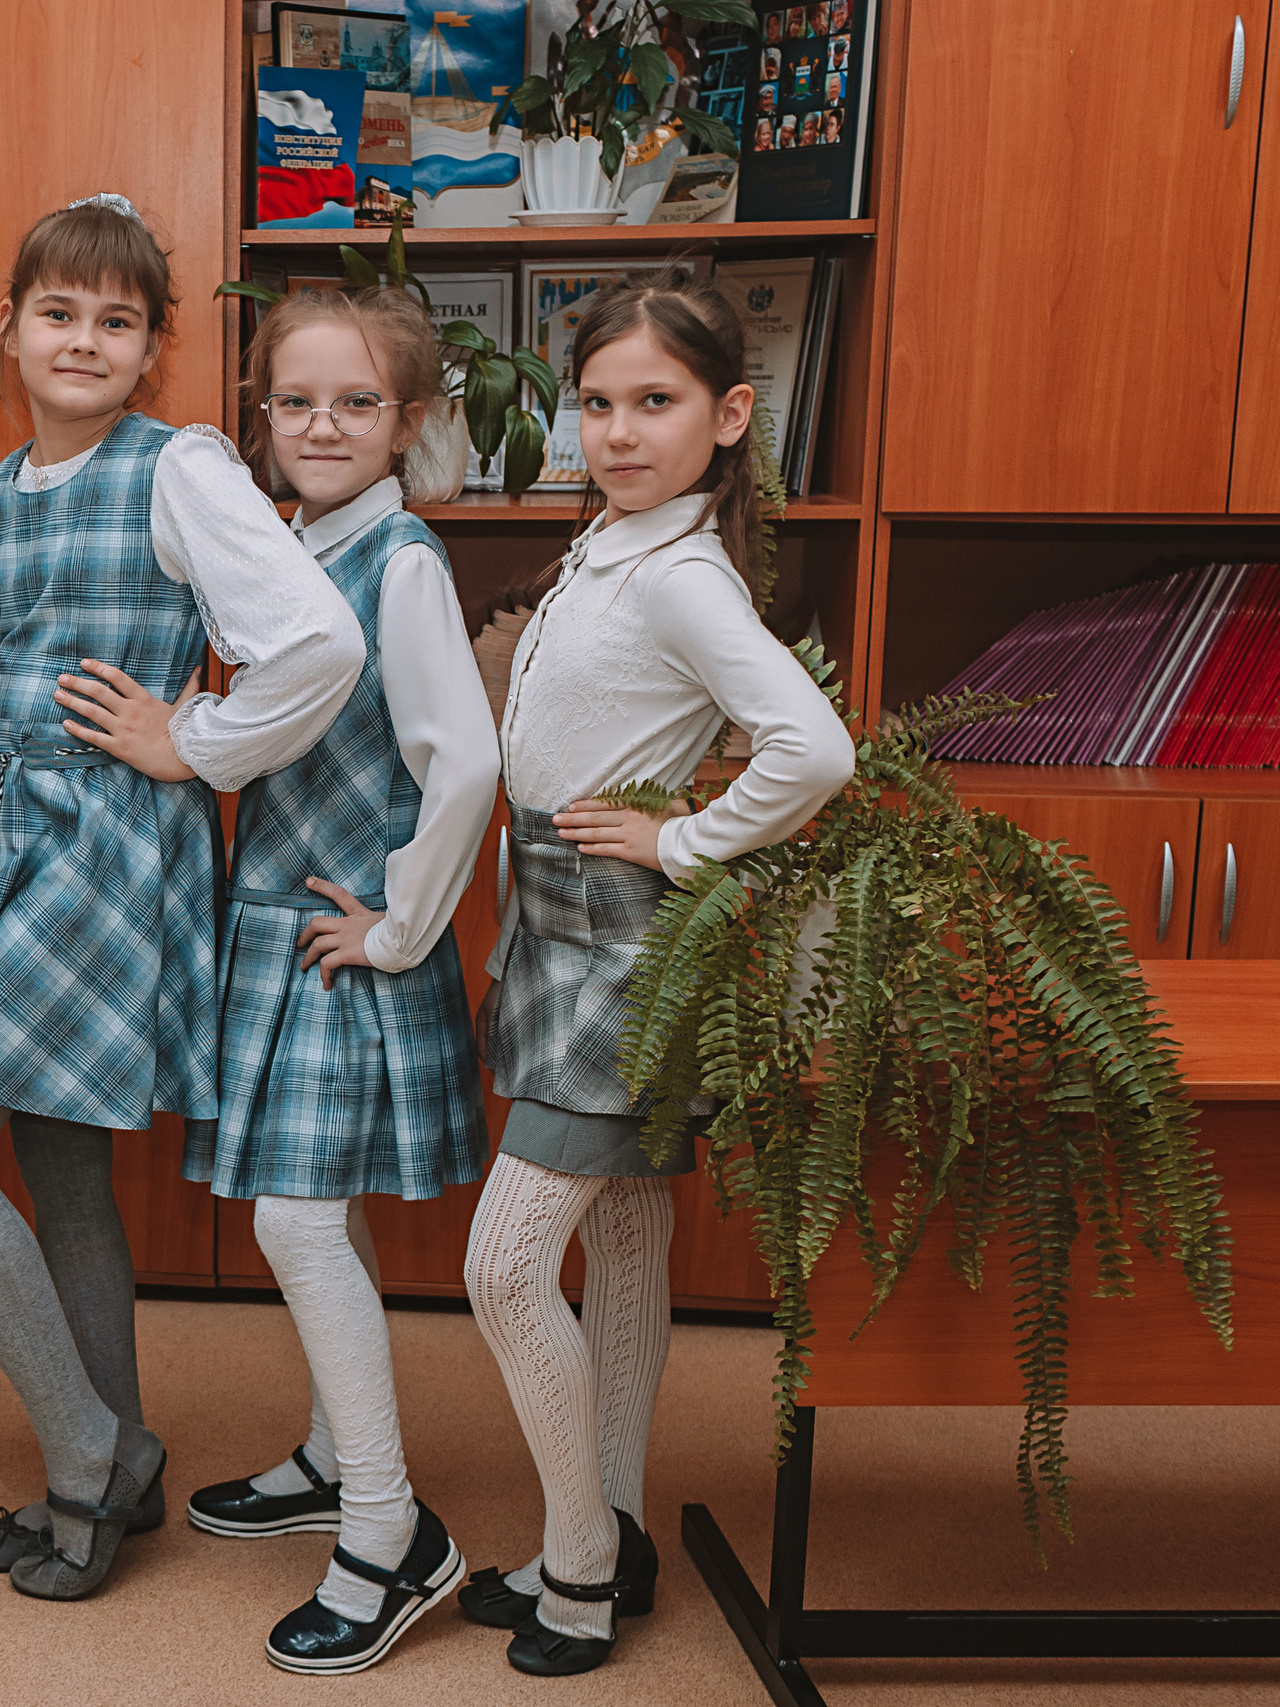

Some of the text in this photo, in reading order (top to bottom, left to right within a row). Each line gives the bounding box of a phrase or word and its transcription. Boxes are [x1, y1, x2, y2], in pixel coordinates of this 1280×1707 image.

[361, 117, 405, 132] МЕНЬ
[276, 146, 339, 157] РОССИЙСКОЙ
[430, 303, 487, 317] ЕТНАЯ
